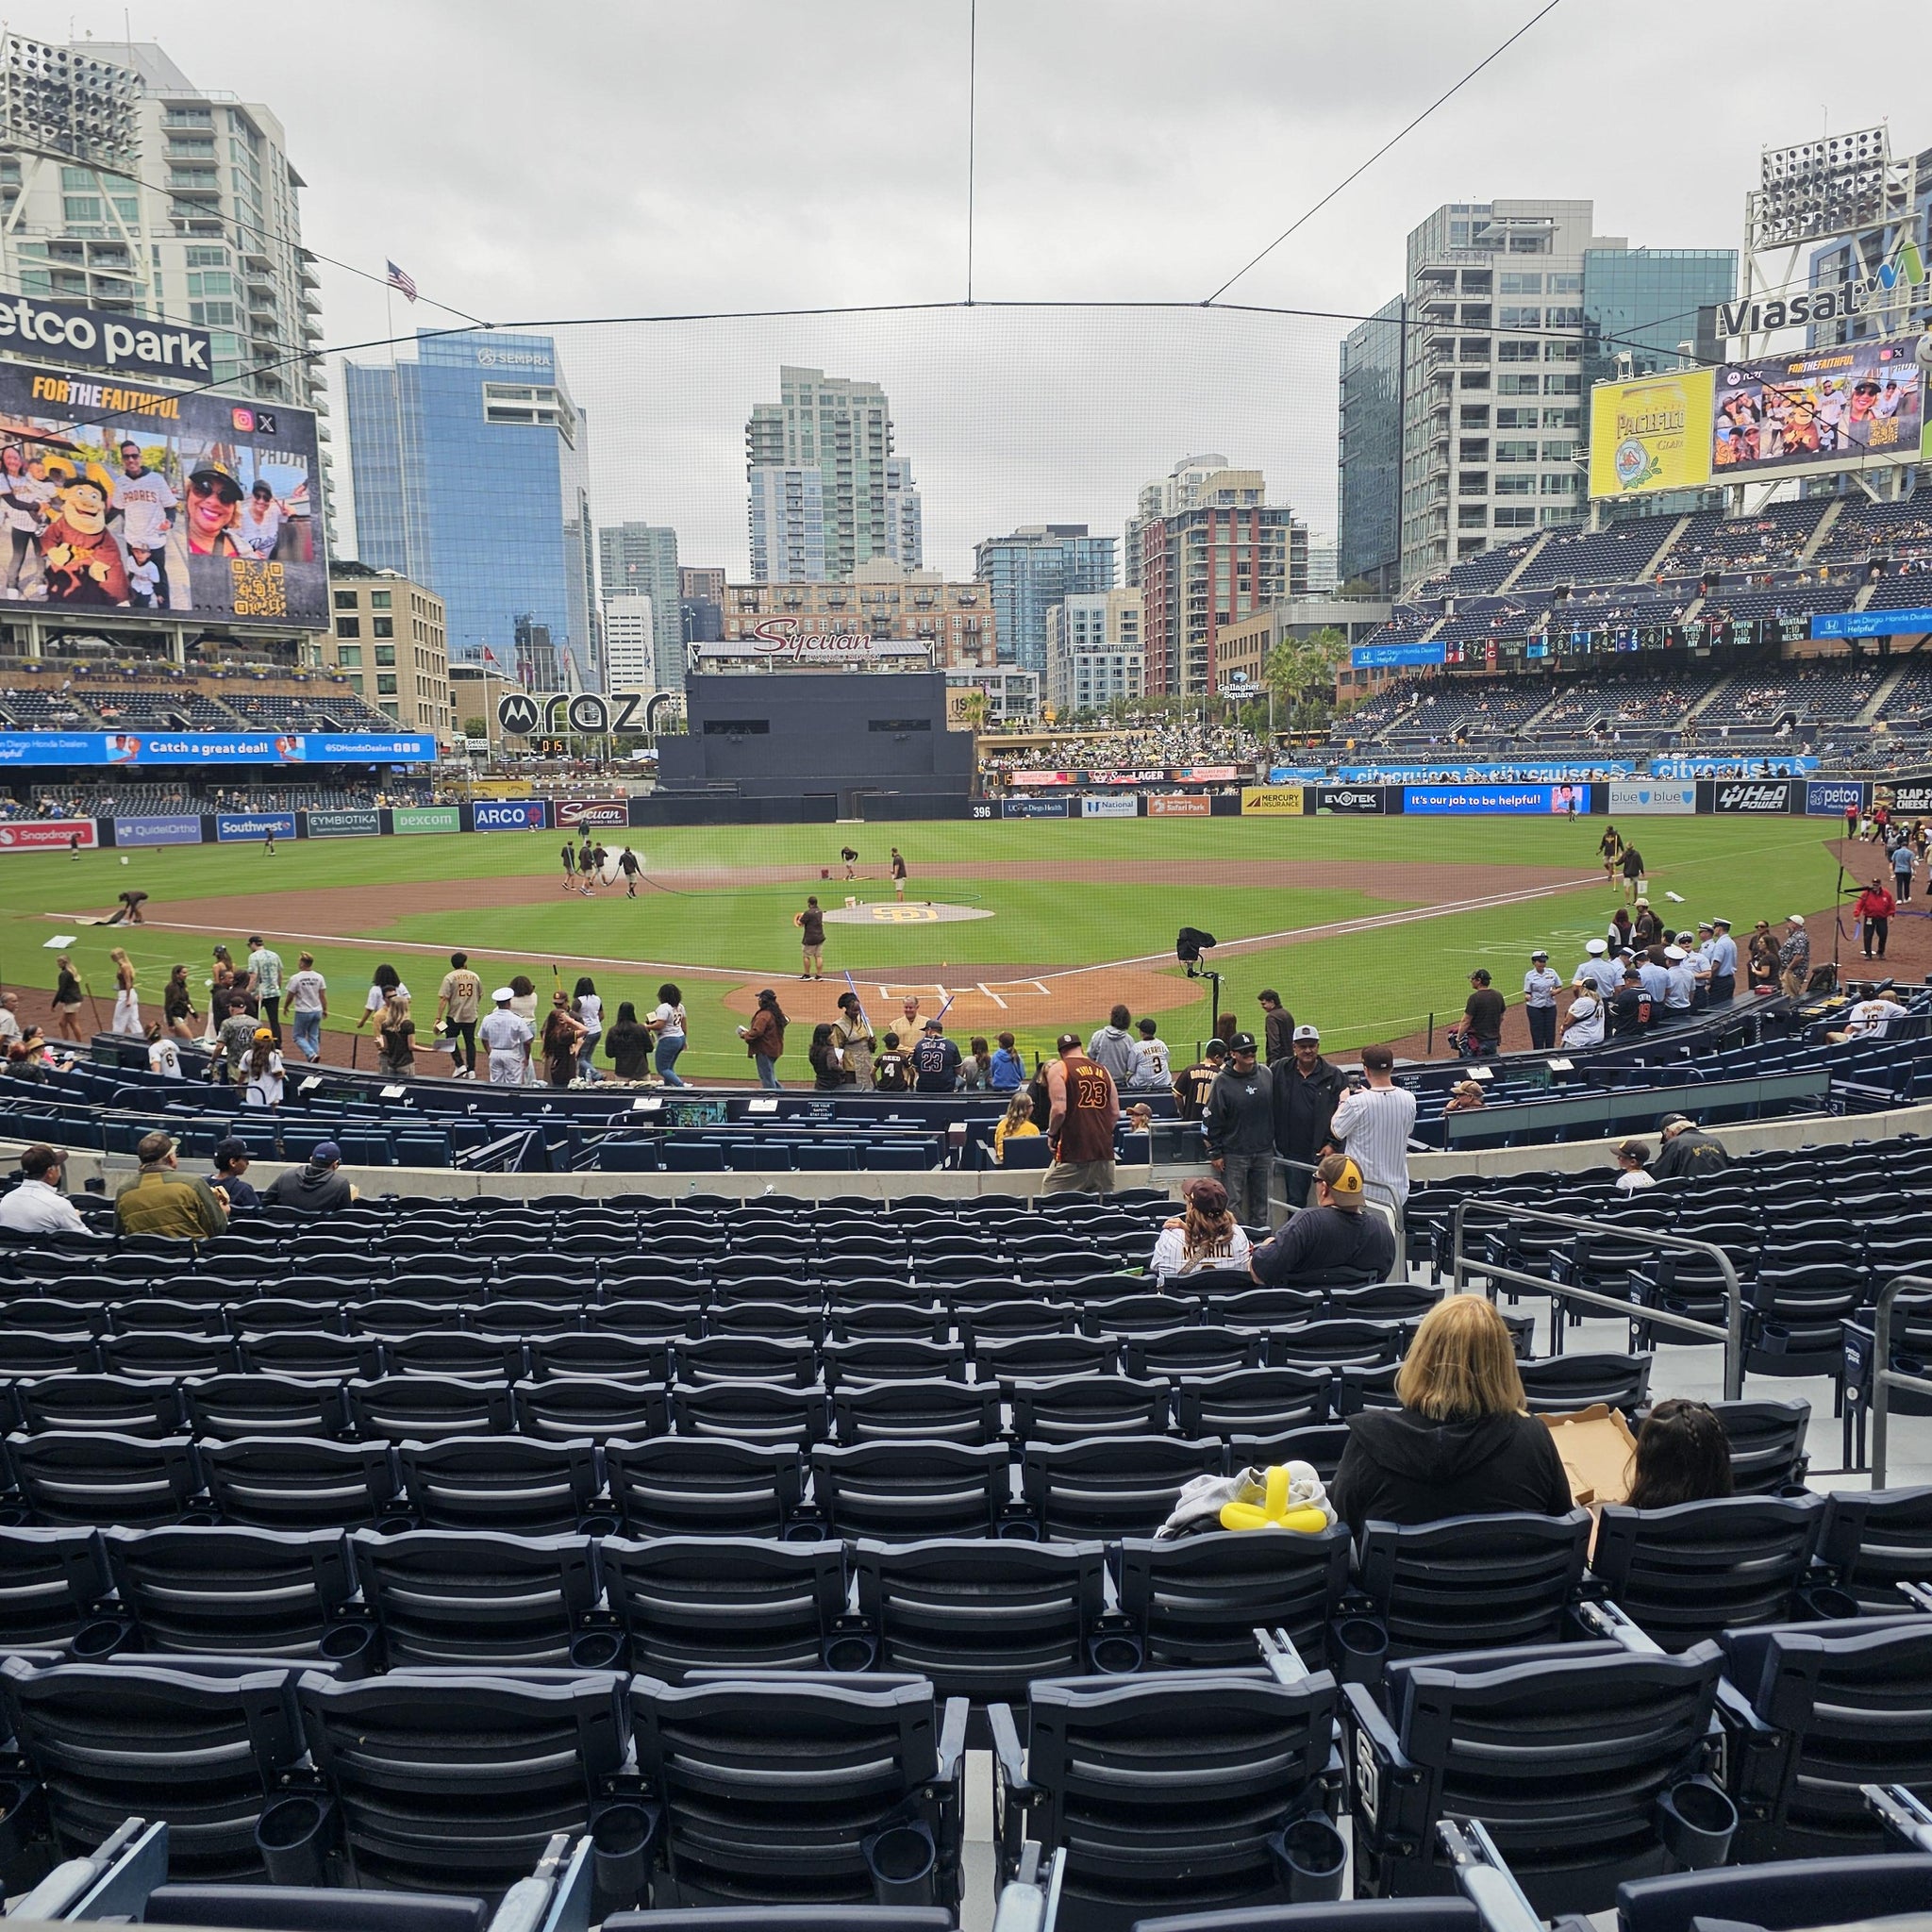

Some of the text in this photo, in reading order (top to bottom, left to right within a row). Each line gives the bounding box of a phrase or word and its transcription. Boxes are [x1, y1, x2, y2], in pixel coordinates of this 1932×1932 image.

[1722, 281, 1860, 338] Viasat
[103, 323, 209, 371] park
[498, 353, 551, 367] SEMPRA
[32, 375, 181, 420] FORTHEFAITHFUL
[754, 616, 874, 662] Sycuan
[1631, 629, 1638, 640] 2
[1458, 641, 1464, 651] 2
[1474, 645, 1478, 655] 7
[1631, 641, 1638, 651] 3
[1458, 651, 1464, 661] 0
[74, 675, 117, 684] ESTRELLA
[1217, 683, 1260, 692] Gallagher
[1224, 691, 1255, 700] Square
[543, 693, 671, 735] razr
[149, 741, 269, 756] Catch a great deal!
[325, 743, 392, 753] @SDHondaDealers
[1132, 771, 1165, 781] LAGER
[1611, 791, 1638, 802] blue
[1654, 791, 1681, 801] blue
[1824, 787, 1859, 807] petco
[1896, 789, 1923, 800] SLAP
[1411, 795, 1428, 805] It's
[1449, 795, 1466, 807] job
[1468, 796, 1480, 805] to
[1482, 795, 1496, 805] be
[1498, 795, 1541, 807] helpful!
[1739, 801, 1783, 809] POWER
[1896, 799, 1929, 810] CHEESE
[476, 808, 525, 824] ARCO
[560, 803, 622, 823] Sycuan
[974, 806, 991, 818] 396
[310, 814, 377, 826] CYMBIOTIKA
[135, 824, 197, 836] QuidelOrtho
[222, 820, 283, 834] Southwest
[458, 983, 474, 997] 23
[1638, 1003, 1652, 1024] 19
[1142, 1046, 1167, 1057] MERRILL
[165, 1053, 175, 1068] 6
[921, 1051, 943, 1073] 23
[1152, 1056, 1162, 1074] 3
[884, 1062, 895, 1077] 4
[1078, 1080, 1108, 1109] 23
[1832, 1103, 1839, 1111] 3
[1348, 1175, 1357, 1191] SD
[1183, 1244, 1233, 1260] MERILL
[1845, 1346, 1861, 1358] petco
[1847, 1354, 1860, 1365] park
